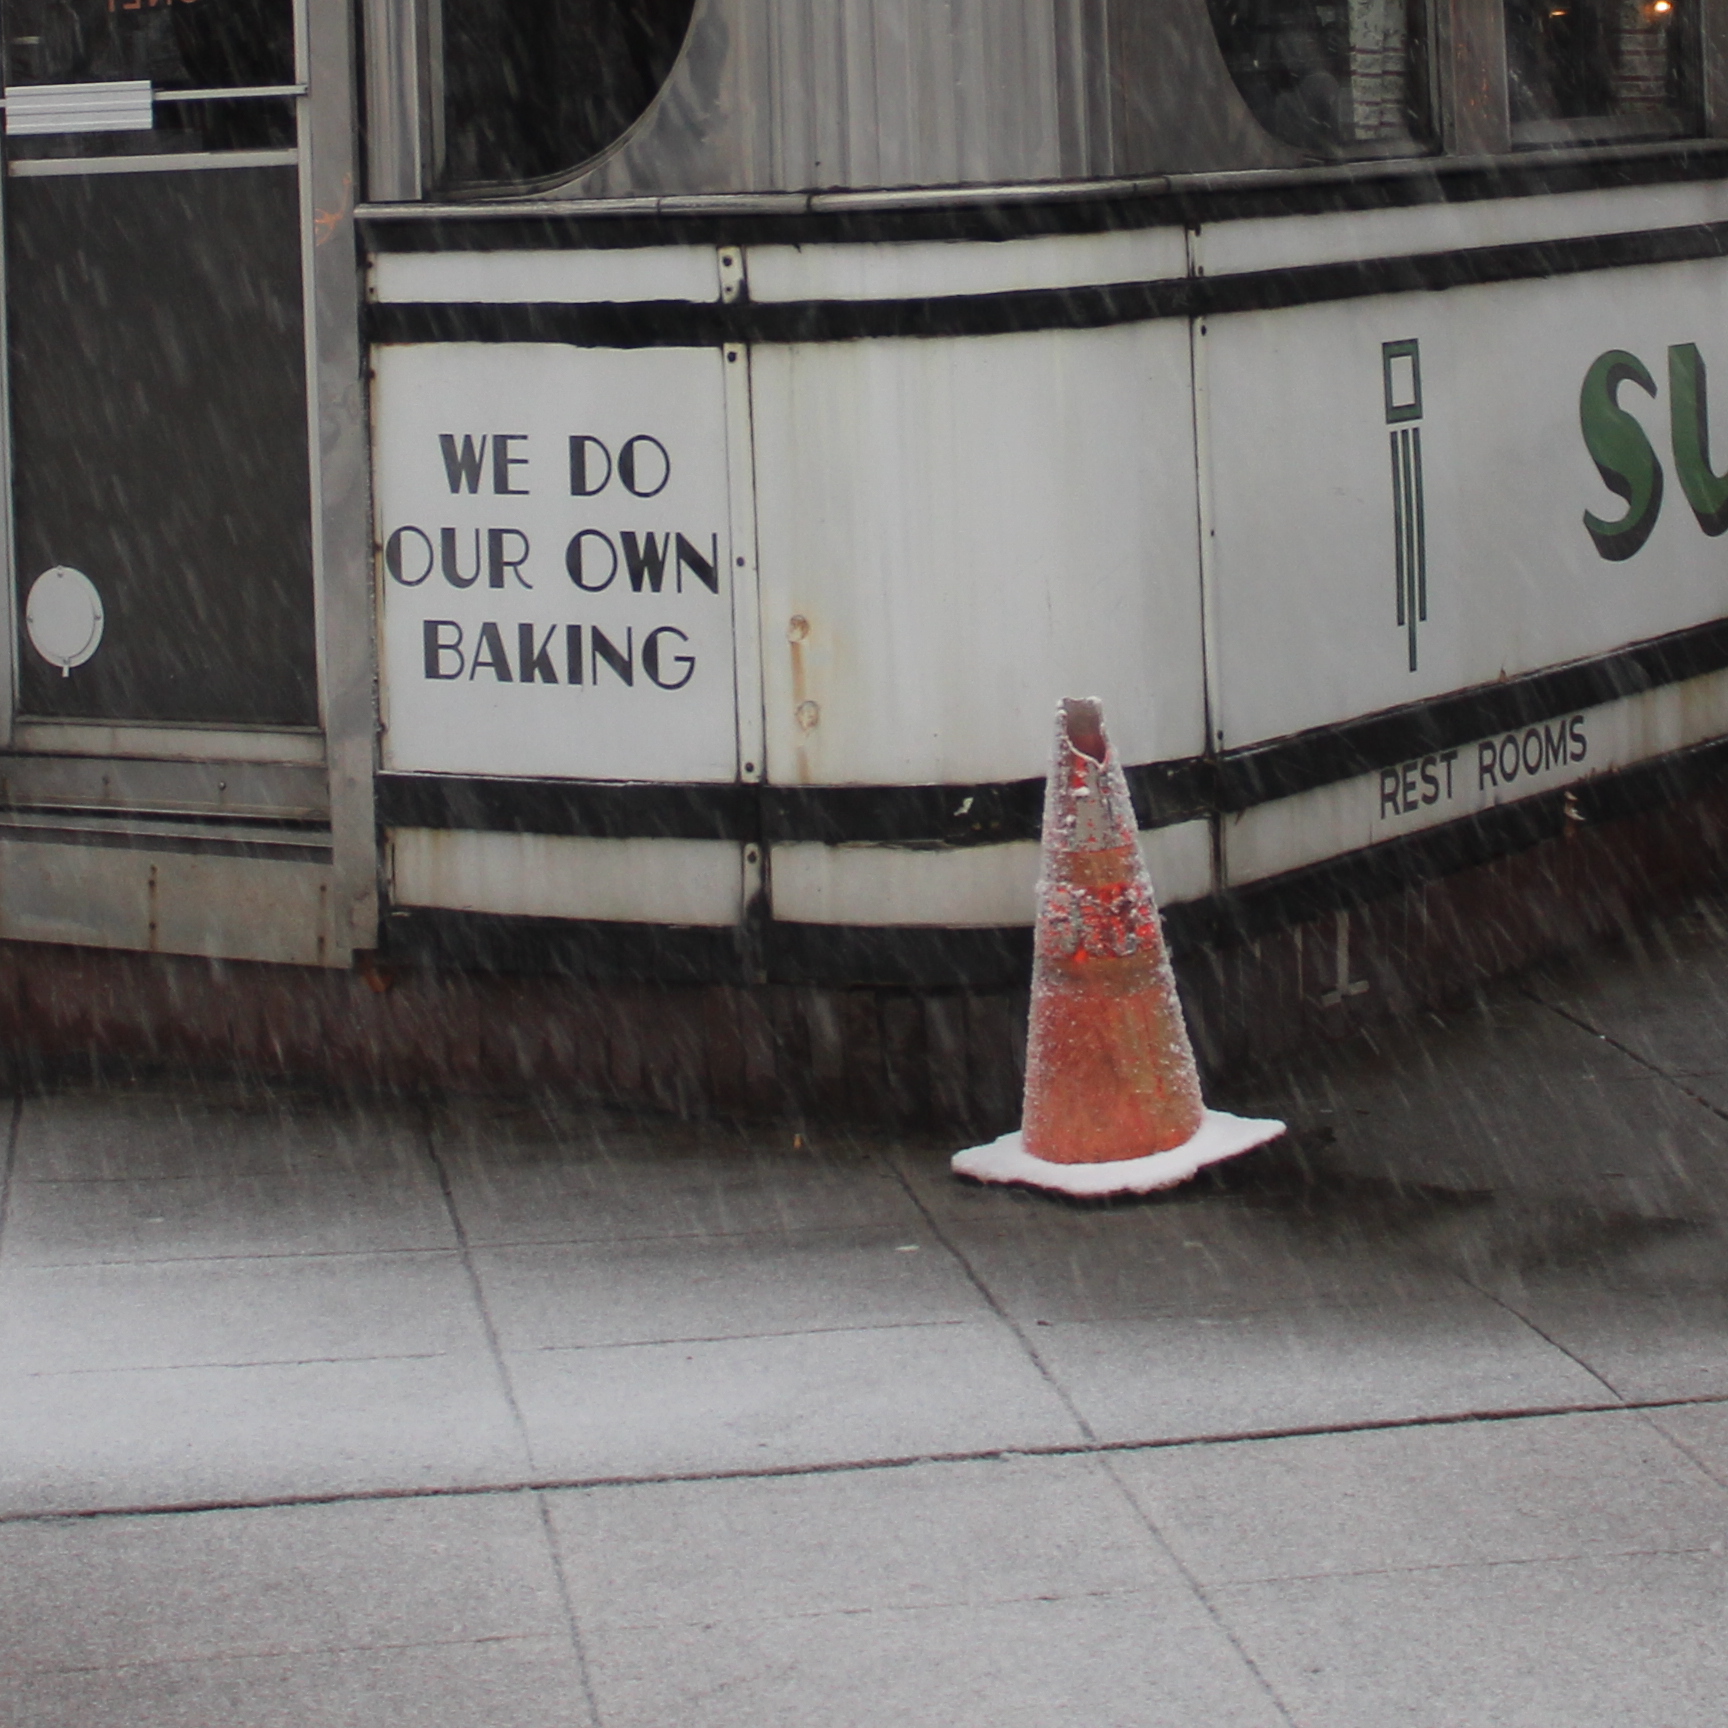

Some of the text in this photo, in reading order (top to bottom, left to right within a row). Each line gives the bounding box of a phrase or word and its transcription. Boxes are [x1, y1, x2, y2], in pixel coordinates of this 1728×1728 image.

[438, 433, 671, 498] WE DO
[384, 525, 720, 595] OUR OWN
[422, 619, 697, 690] BAKING
[1380, 714, 1588, 820] REST ROOMS
